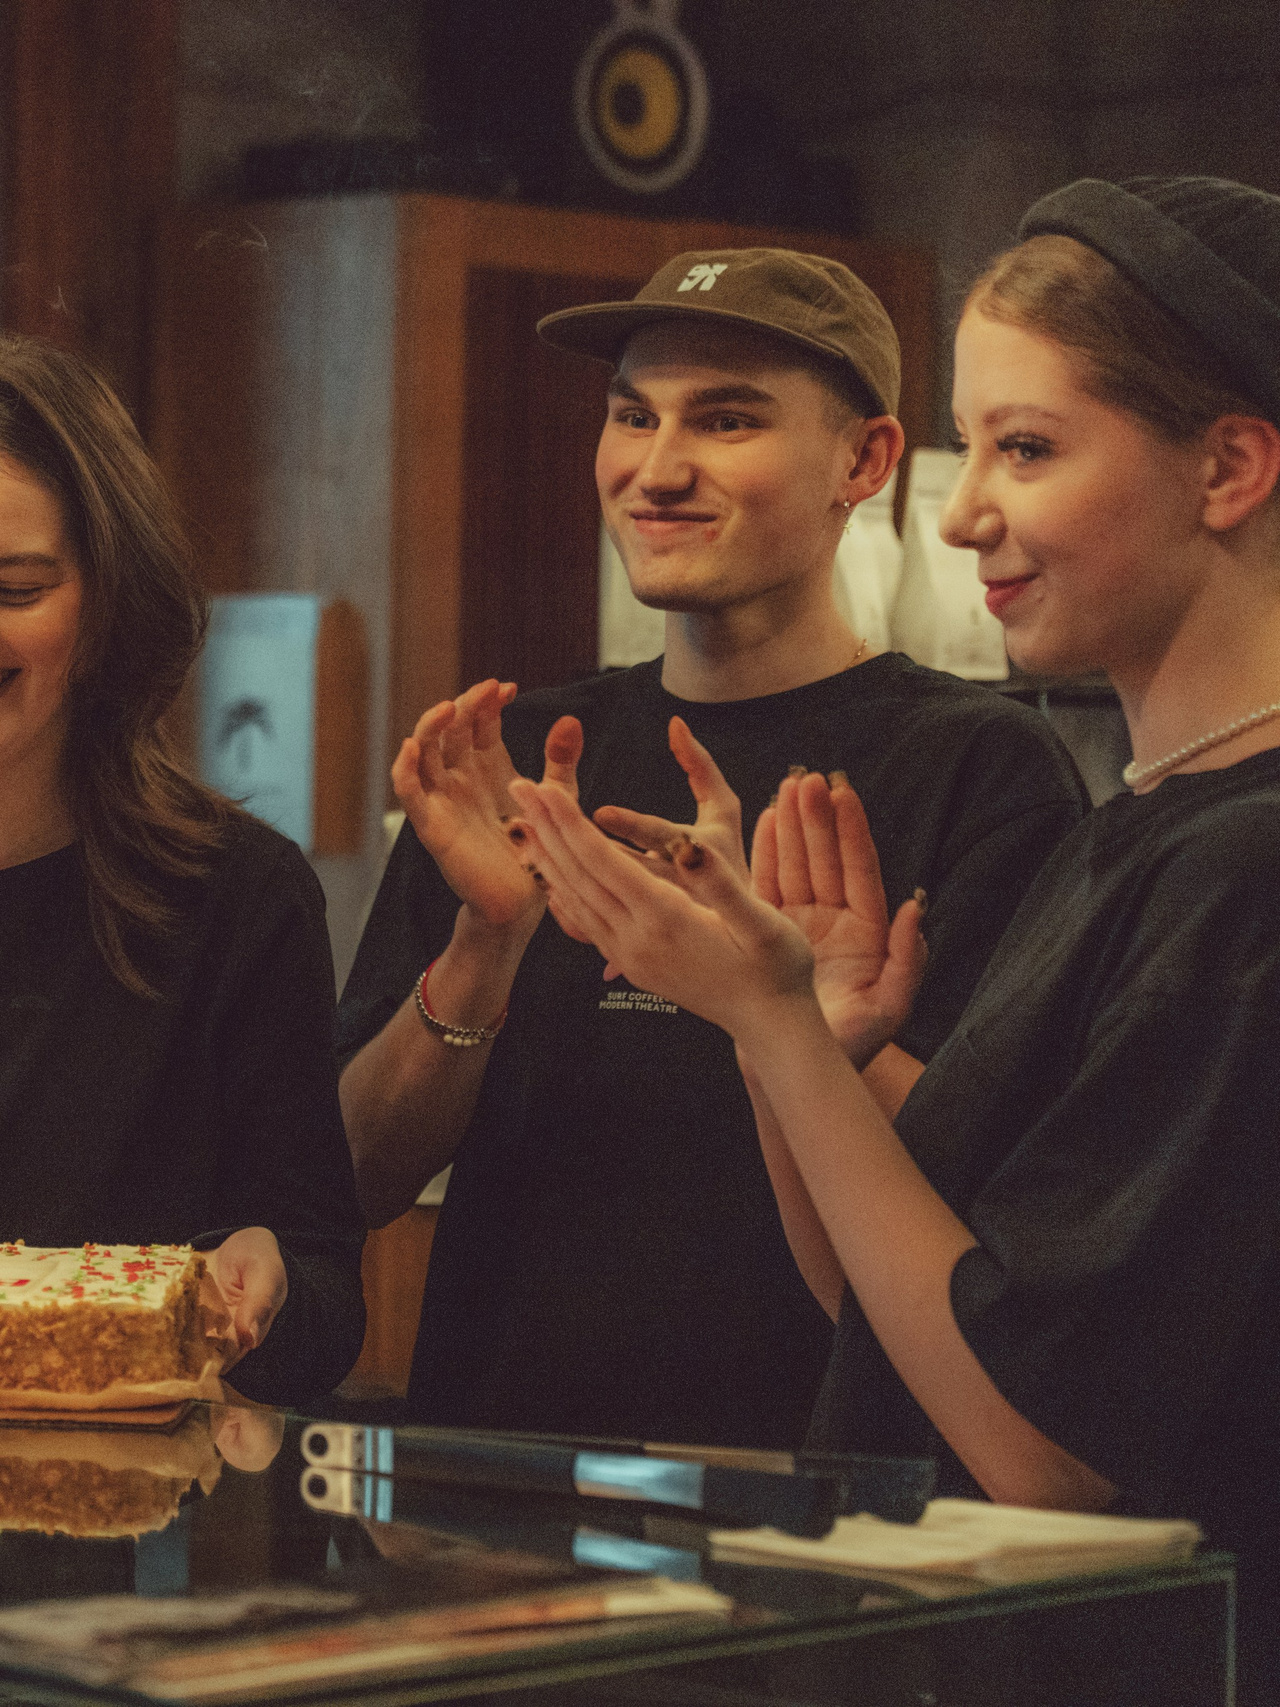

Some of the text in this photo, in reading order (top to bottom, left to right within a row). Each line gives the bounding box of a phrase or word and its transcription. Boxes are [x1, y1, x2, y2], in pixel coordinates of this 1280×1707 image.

[607, 992, 664, 1003] SURF COFFEE
[599, 1001, 678, 1014] MODERN THEATRE
